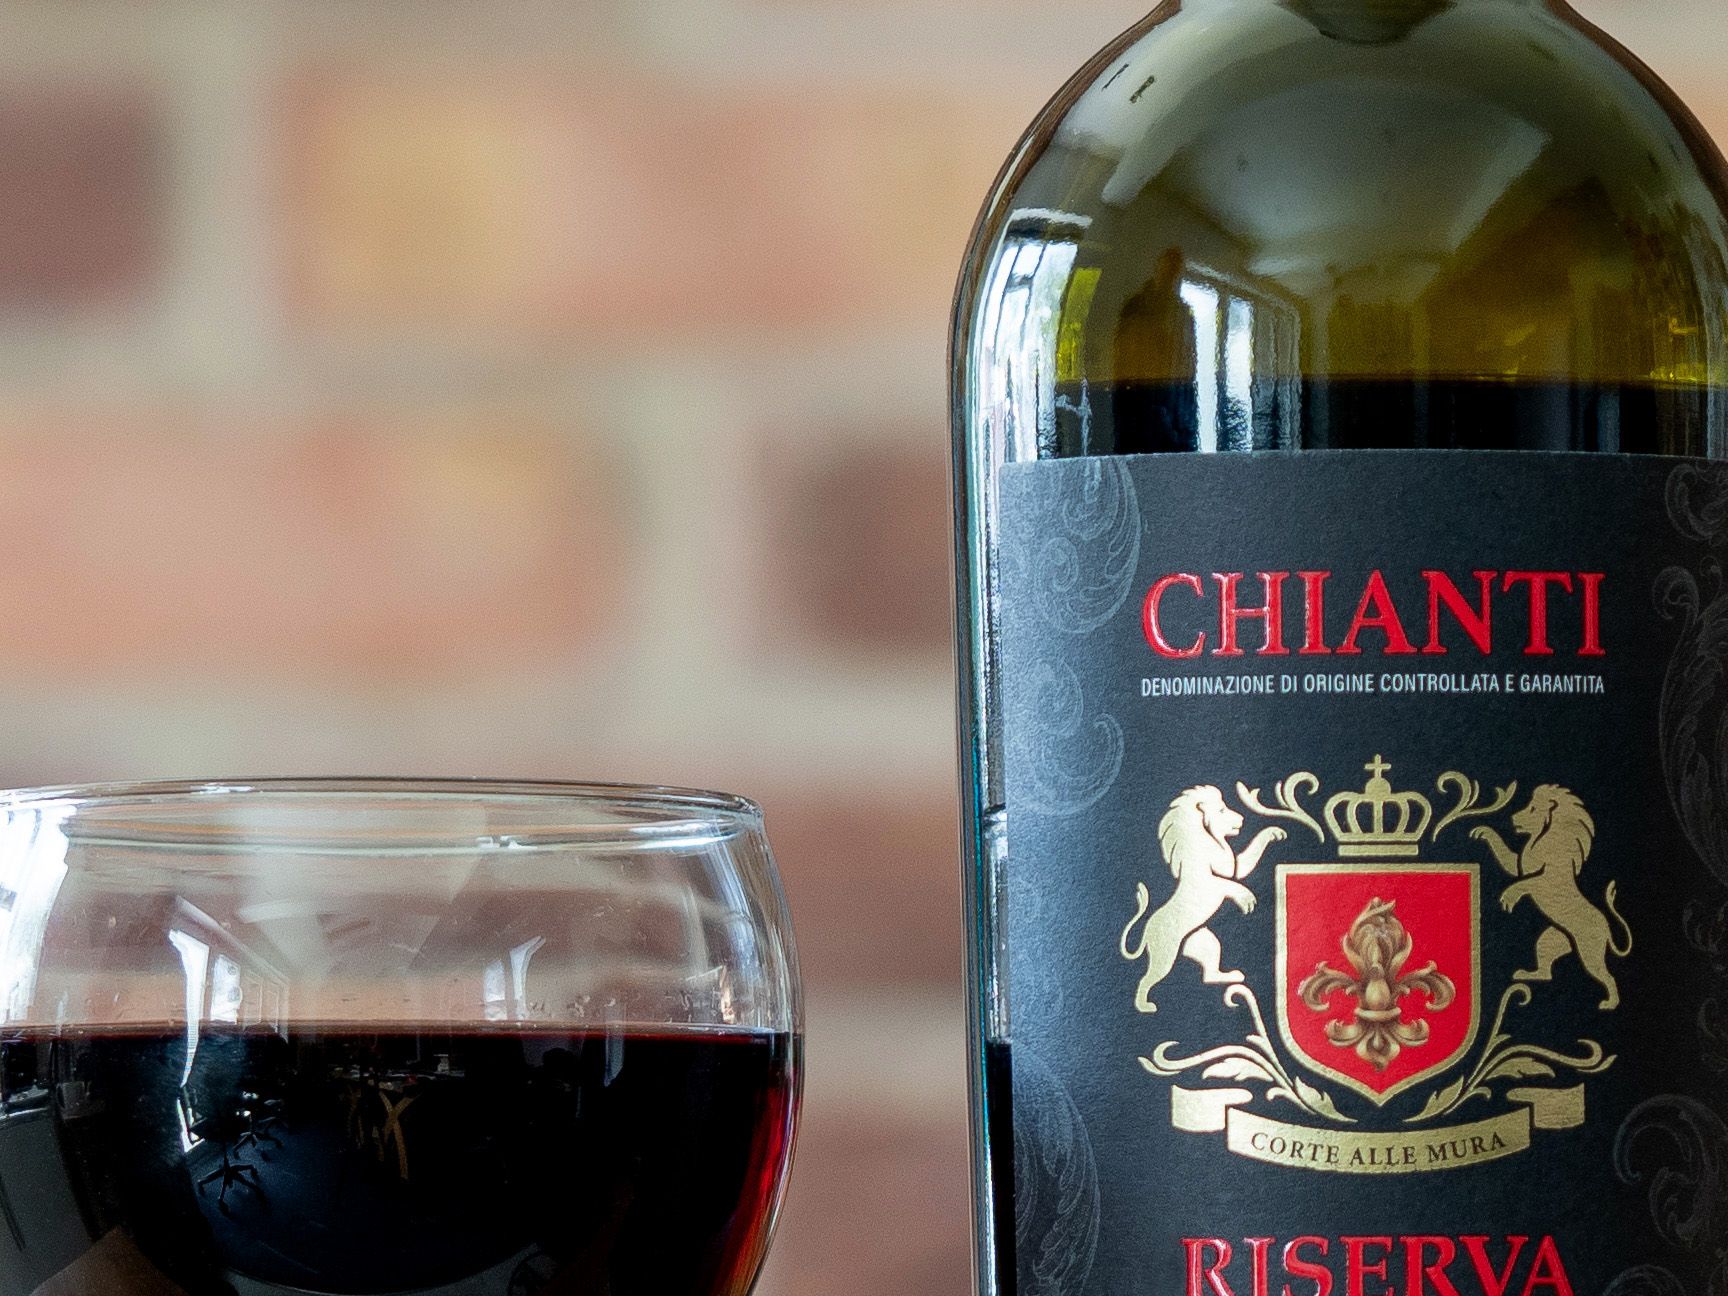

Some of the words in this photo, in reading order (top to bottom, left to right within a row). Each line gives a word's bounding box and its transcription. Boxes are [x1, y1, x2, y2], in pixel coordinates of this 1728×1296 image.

[1141, 569, 1607, 659] CHIANTI
[1141, 674, 1275, 697] DENOMINAZIONE
[1280, 674, 1298, 694] DI
[1303, 673, 1375, 693] ORIGINE
[1379, 673, 1500, 693] CONTROLLATA
[1504, 673, 1515, 693] E
[1519, 674, 1605, 694] GARANTITA
[1250, 1132, 1340, 1164] CORTE
[1351, 1145, 1418, 1167] ALLE
[1427, 1131, 1506, 1163] MURA
